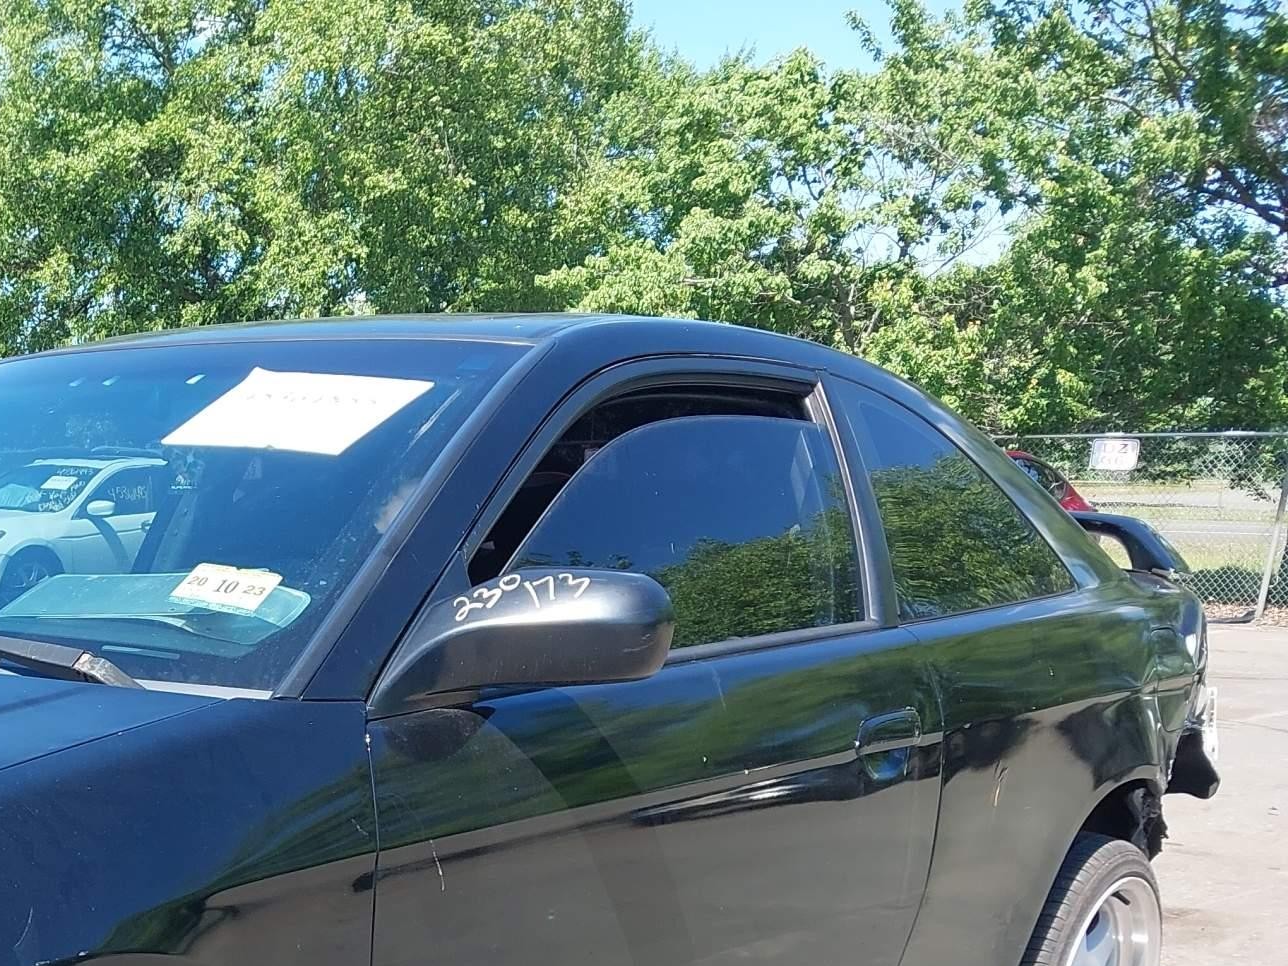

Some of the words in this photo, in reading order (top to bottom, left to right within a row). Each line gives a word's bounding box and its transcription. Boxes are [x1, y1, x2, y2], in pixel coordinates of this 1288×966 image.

[187, 575, 209, 586] 20
[213, 578, 240, 594] 10
[242, 584, 267, 596] 23
